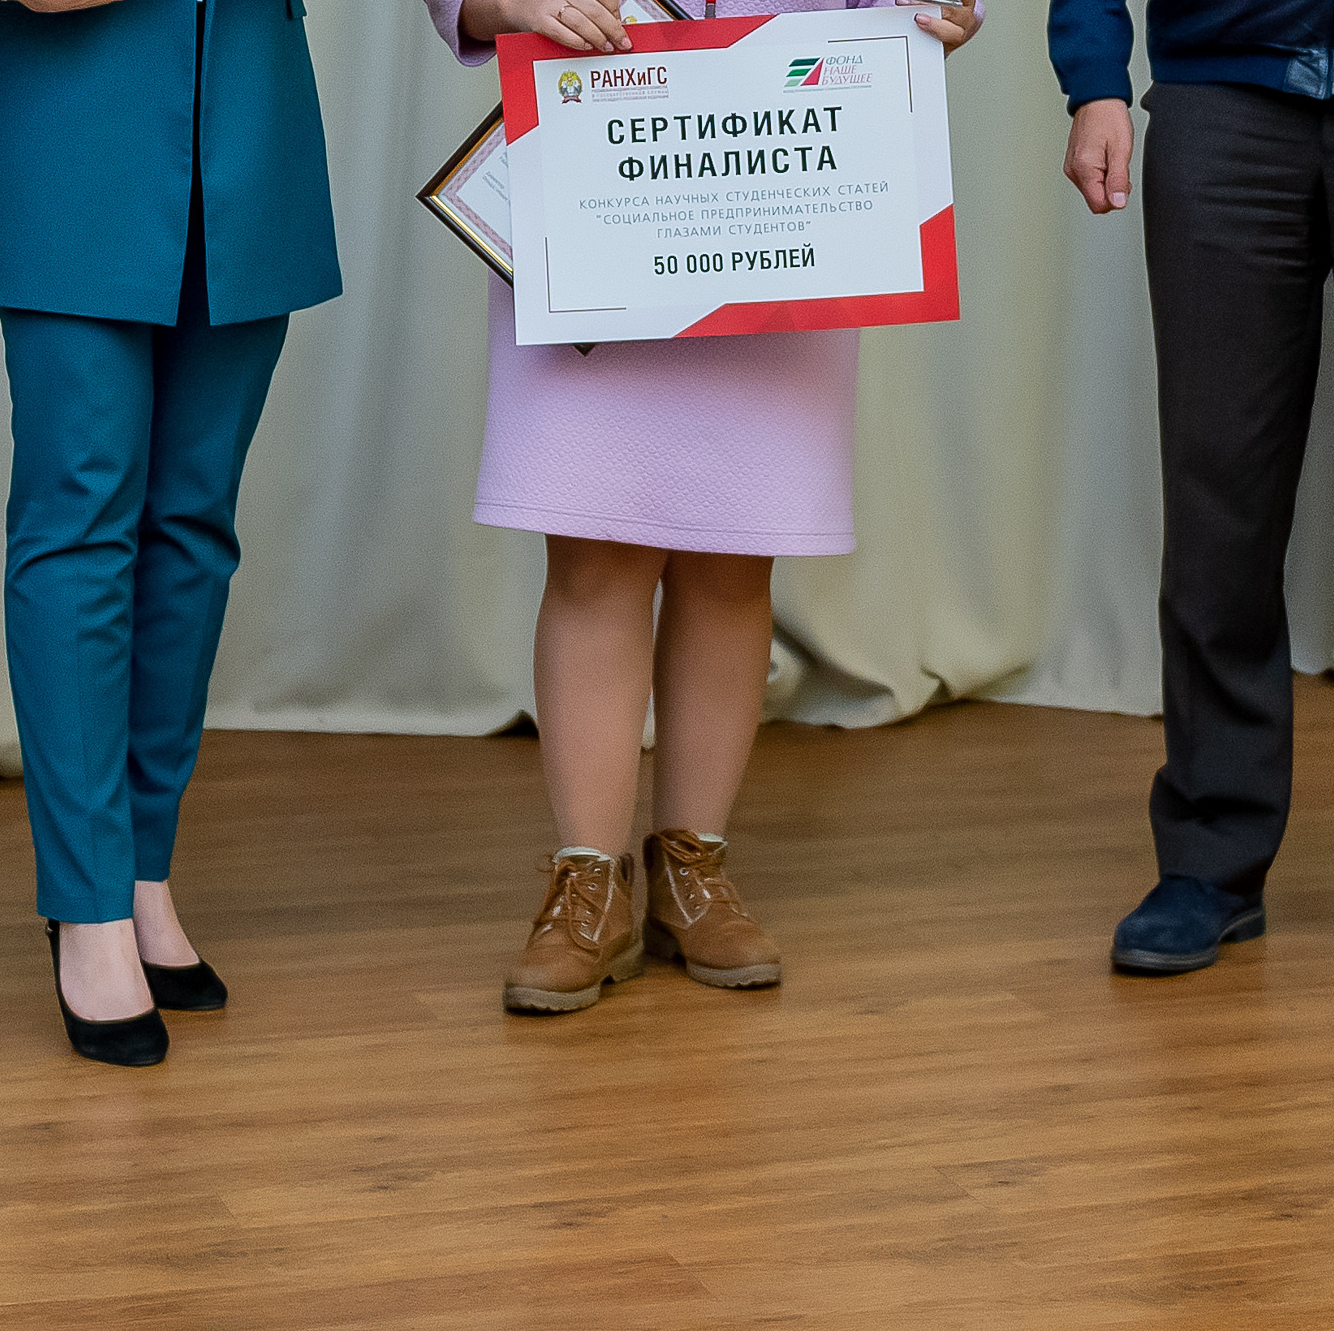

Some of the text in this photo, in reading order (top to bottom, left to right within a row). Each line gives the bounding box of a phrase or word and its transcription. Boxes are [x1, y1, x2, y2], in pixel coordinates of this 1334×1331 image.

[822, 64, 858, 75] НАШЕ
[825, 54, 864, 66] ФОНД
[590, 66, 668, 89] РАНХиГС
[821, 72, 873, 86] БУДУЩЕЕ
[607, 106, 843, 145] СЕРТИФИКАТ
[618, 145, 838, 181] ФИНАЛИСТА
[579, 180, 889, 210] КОНКУРСА НАУЧНЫХ СТУДЕНЧЕСКИХ СТАТЕЙ
[700, 199, 874, 220] ПРЕДПРИНИМАТЕЛЬСТВО
[656, 225, 722, 239] ГЛАЗАМИ
[654, 242, 816, 276] 50 000 РУБЛЕЙ
